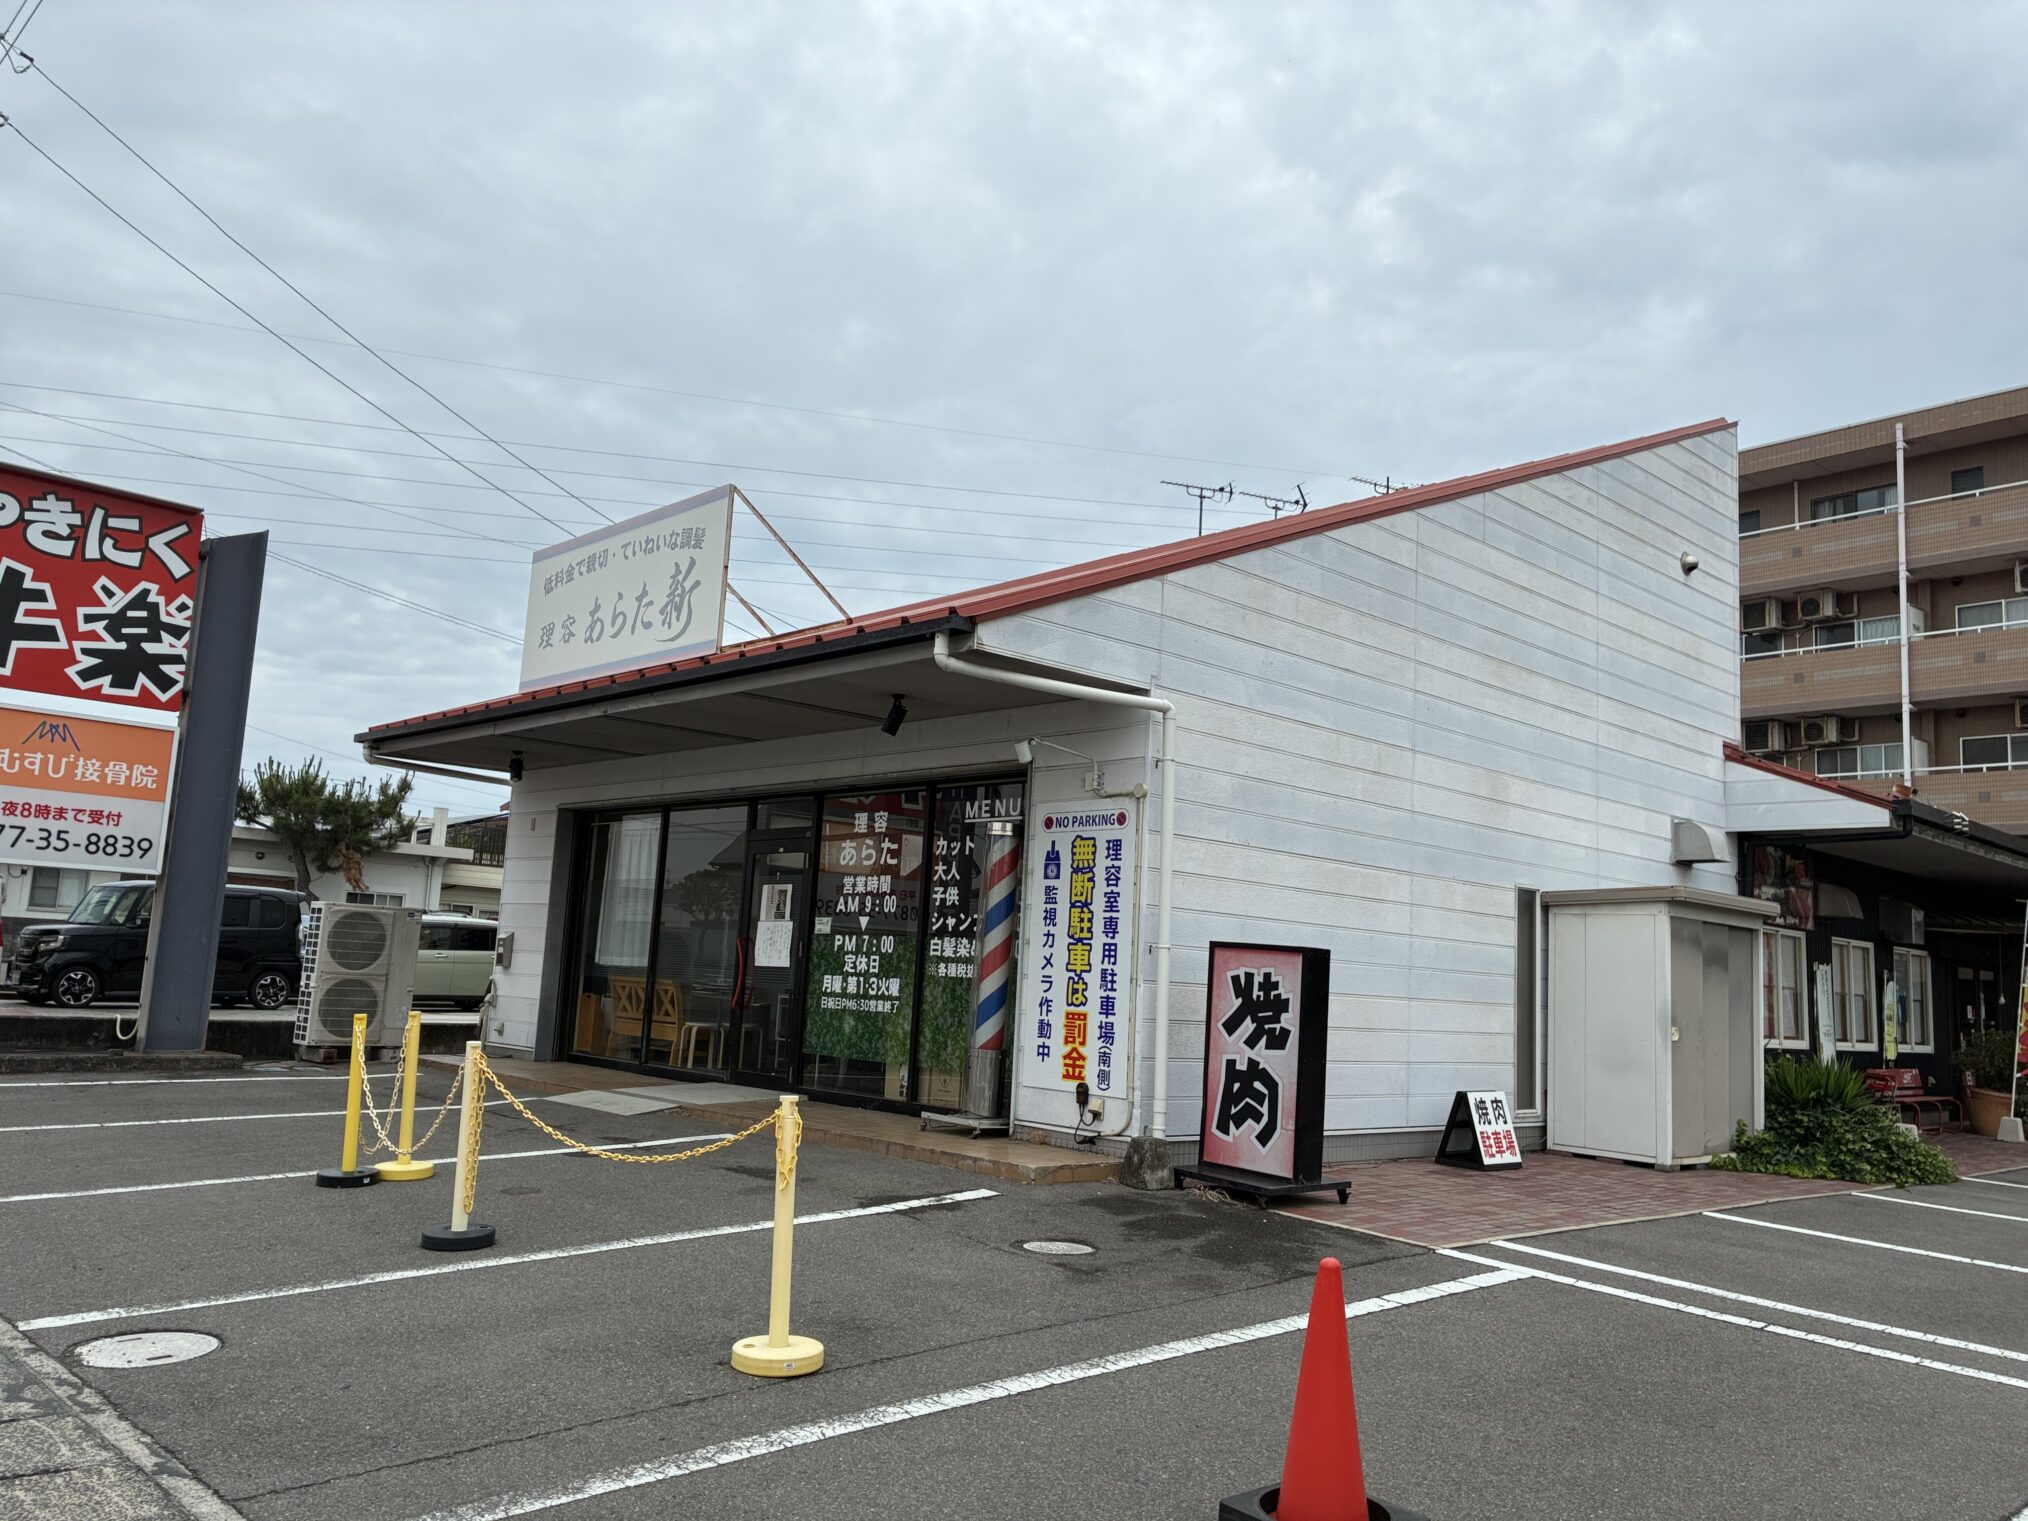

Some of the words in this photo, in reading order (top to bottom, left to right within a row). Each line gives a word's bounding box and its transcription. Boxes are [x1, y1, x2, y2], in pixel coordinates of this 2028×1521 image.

[0, 491, 195, 584] きにく
[1, 801, 123, 827] 夜8時まで受付
[965, 798, 1022, 819] MENU
[854, 811, 888, 833] 理容
[1055, 816, 1070, 829] NO
[1072, 813, 1116, 828] PARKING
[840, 837, 898, 866] あらた
[935, 835, 975, 856] カット
[933, 861, 960, 881] 大人
[843, 875, 891, 894] 営業時間
[836, 895, 859, 913] AM
[932, 886, 959, 906] 子供
[931, 912, 978, 932] シャン
[834, 934, 856, 952] PM
[843, 954, 879, 973] 定休日
[1036, 885, 1058, 1063] 監視カメラ作動中
[1212, 967, 1295, 1154] 焼肉
[1474, 1097, 1508, 1126] 焼肉
[1480, 1130, 1517, 1158] 駐車場
